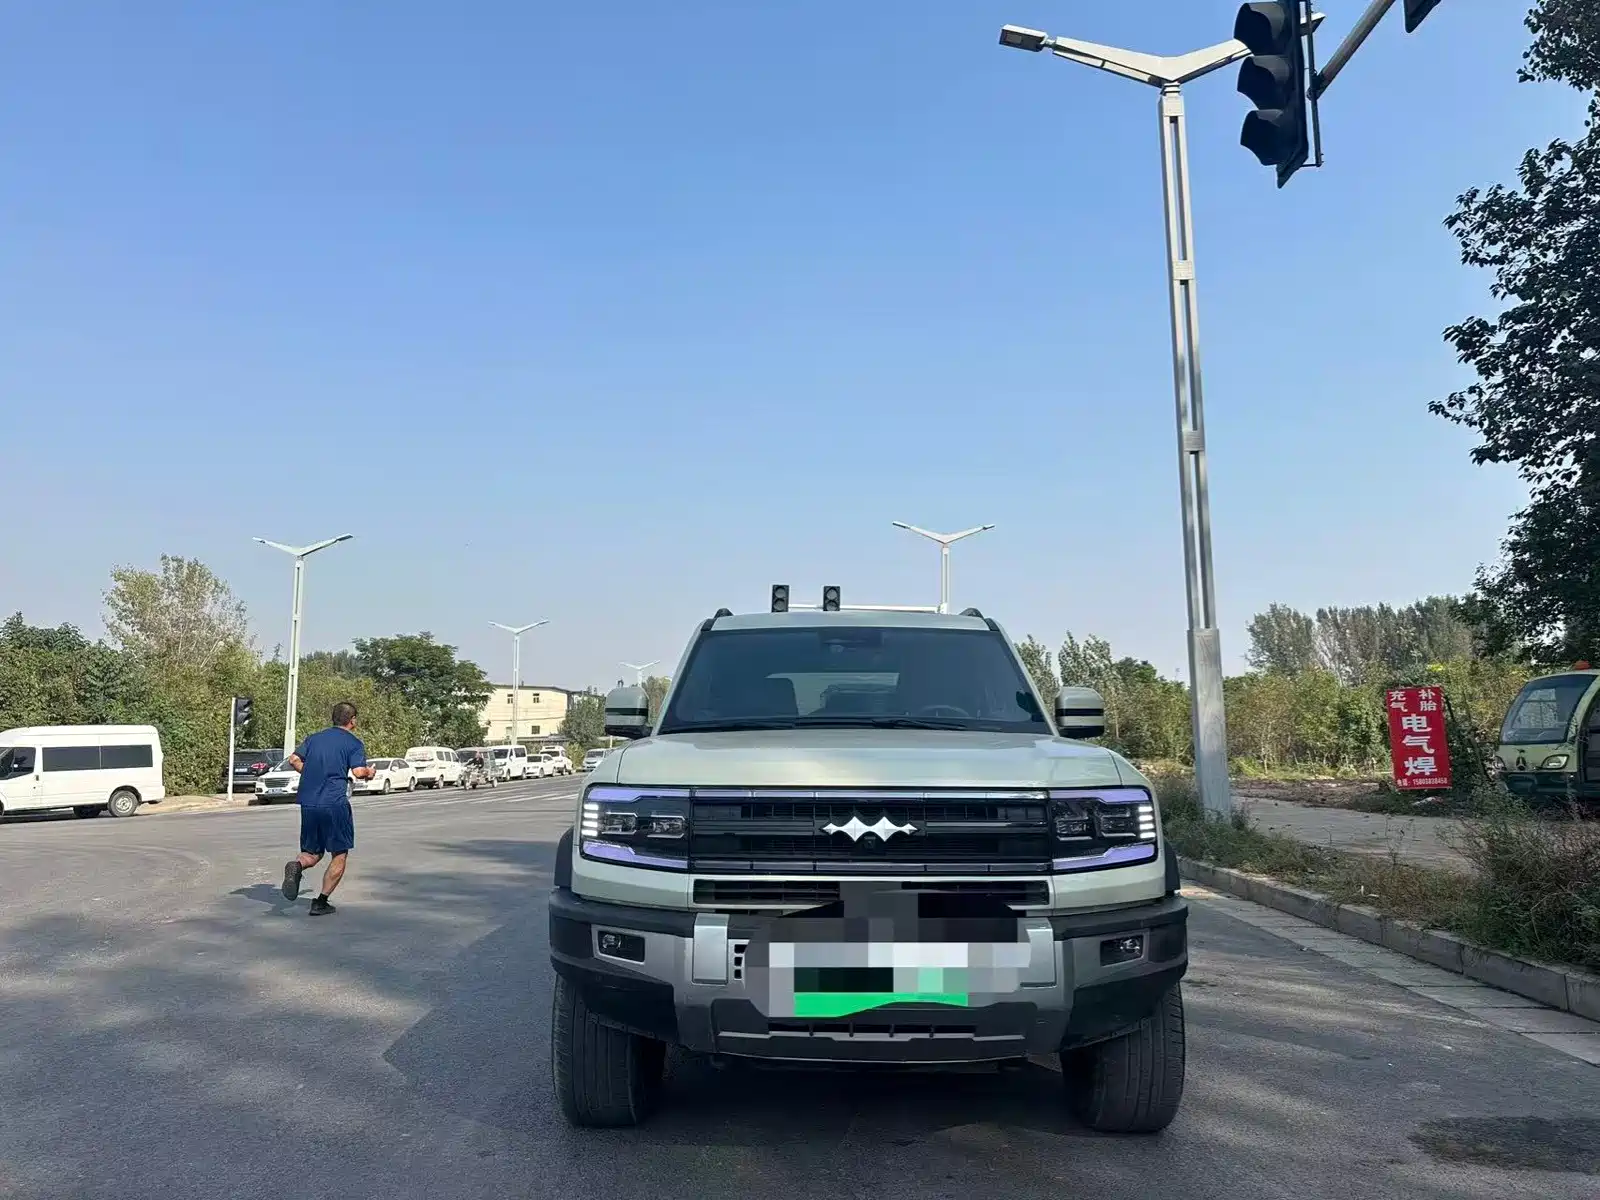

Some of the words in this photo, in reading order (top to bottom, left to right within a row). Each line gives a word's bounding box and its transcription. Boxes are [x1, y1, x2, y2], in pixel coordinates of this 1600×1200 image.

[1389, 690, 1408, 712] 充气
[1418, 689, 1437, 711] 补胎
[1402, 713, 1438, 776] 电气焊
